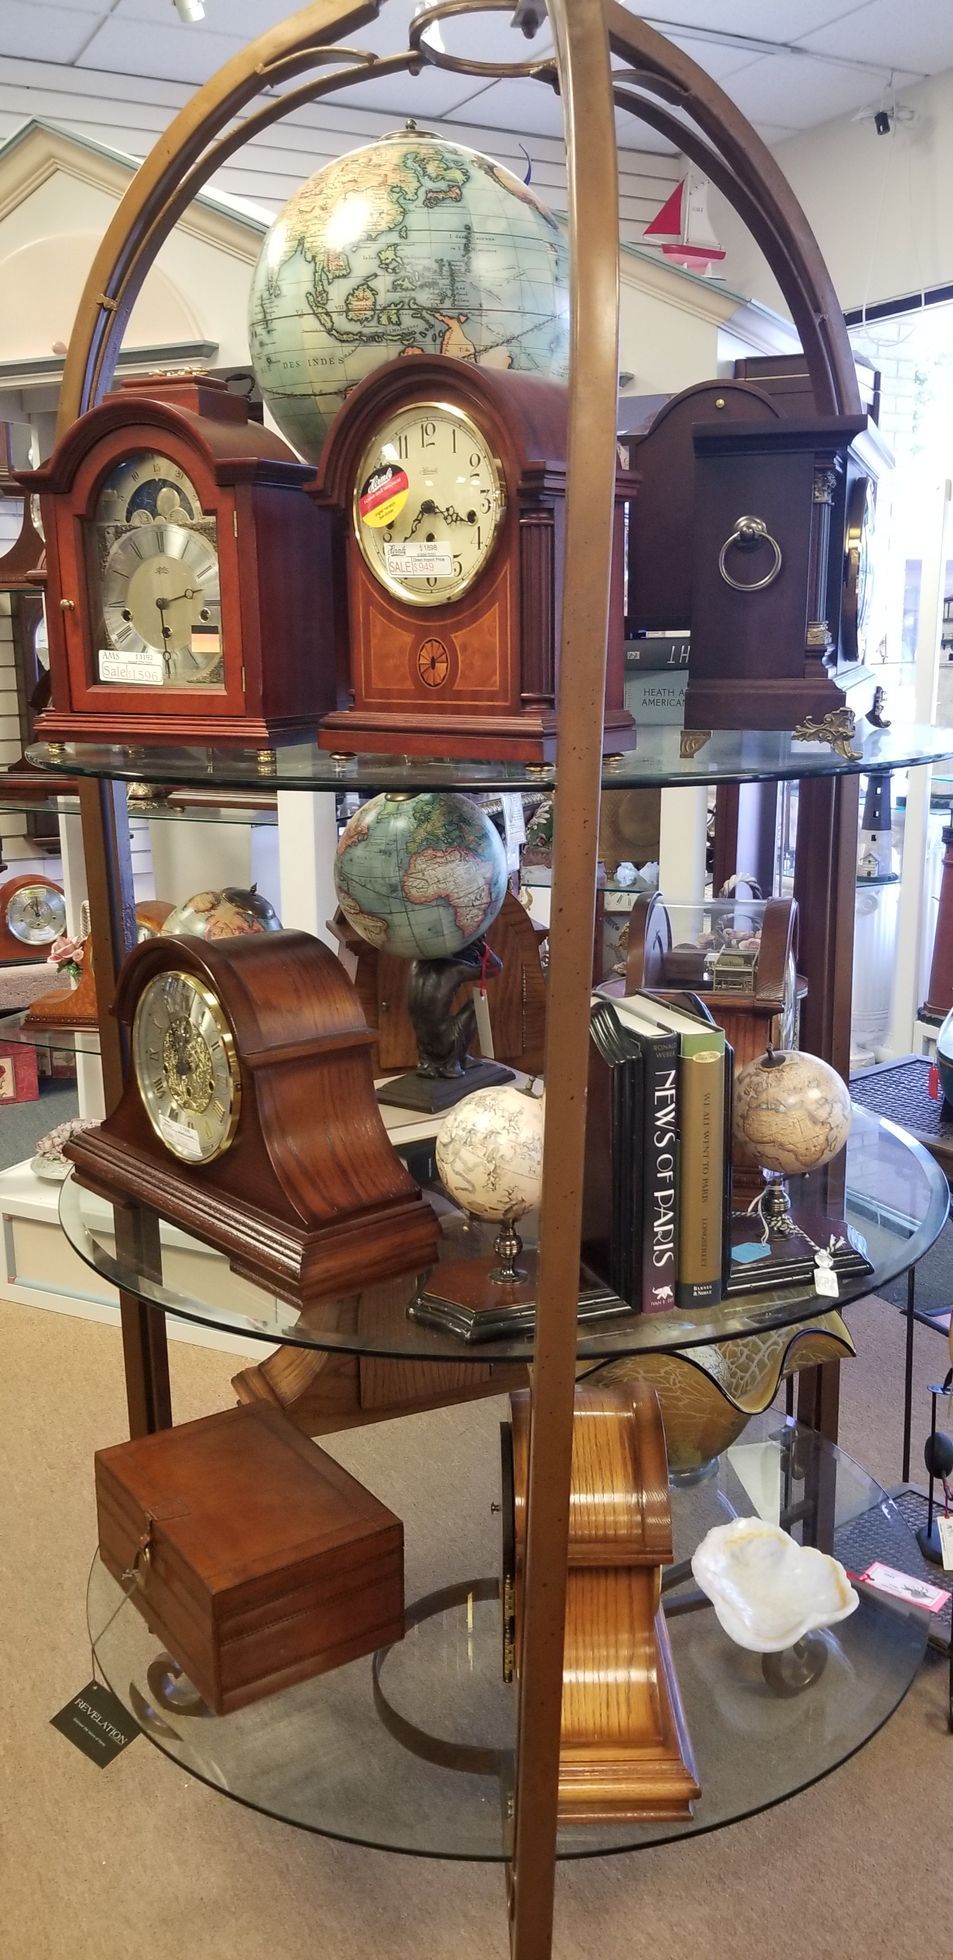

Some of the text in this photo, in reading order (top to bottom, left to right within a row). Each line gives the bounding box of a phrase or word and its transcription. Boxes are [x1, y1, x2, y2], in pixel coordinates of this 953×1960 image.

[282, 360, 301, 370] DES
[307, 357, 345, 367] INDES
[399, 434, 409, 460] 11
[420, 422, 436, 448] 12
[452, 428, 457, 454] 1
[469, 452, 481, 478] 2
[480, 488, 492, 515] 3
[470, 525, 484, 551] 4
[389, 561, 435, 573] SALE $949
[102, 651, 120, 660] AMS
[103, 665, 127, 678] Sale
[643, 688, 675, 696] HEATH
[652, 1069, 676, 1267] NEWS OF PARIS
[74, 1698, 128, 1746] REVELATION
